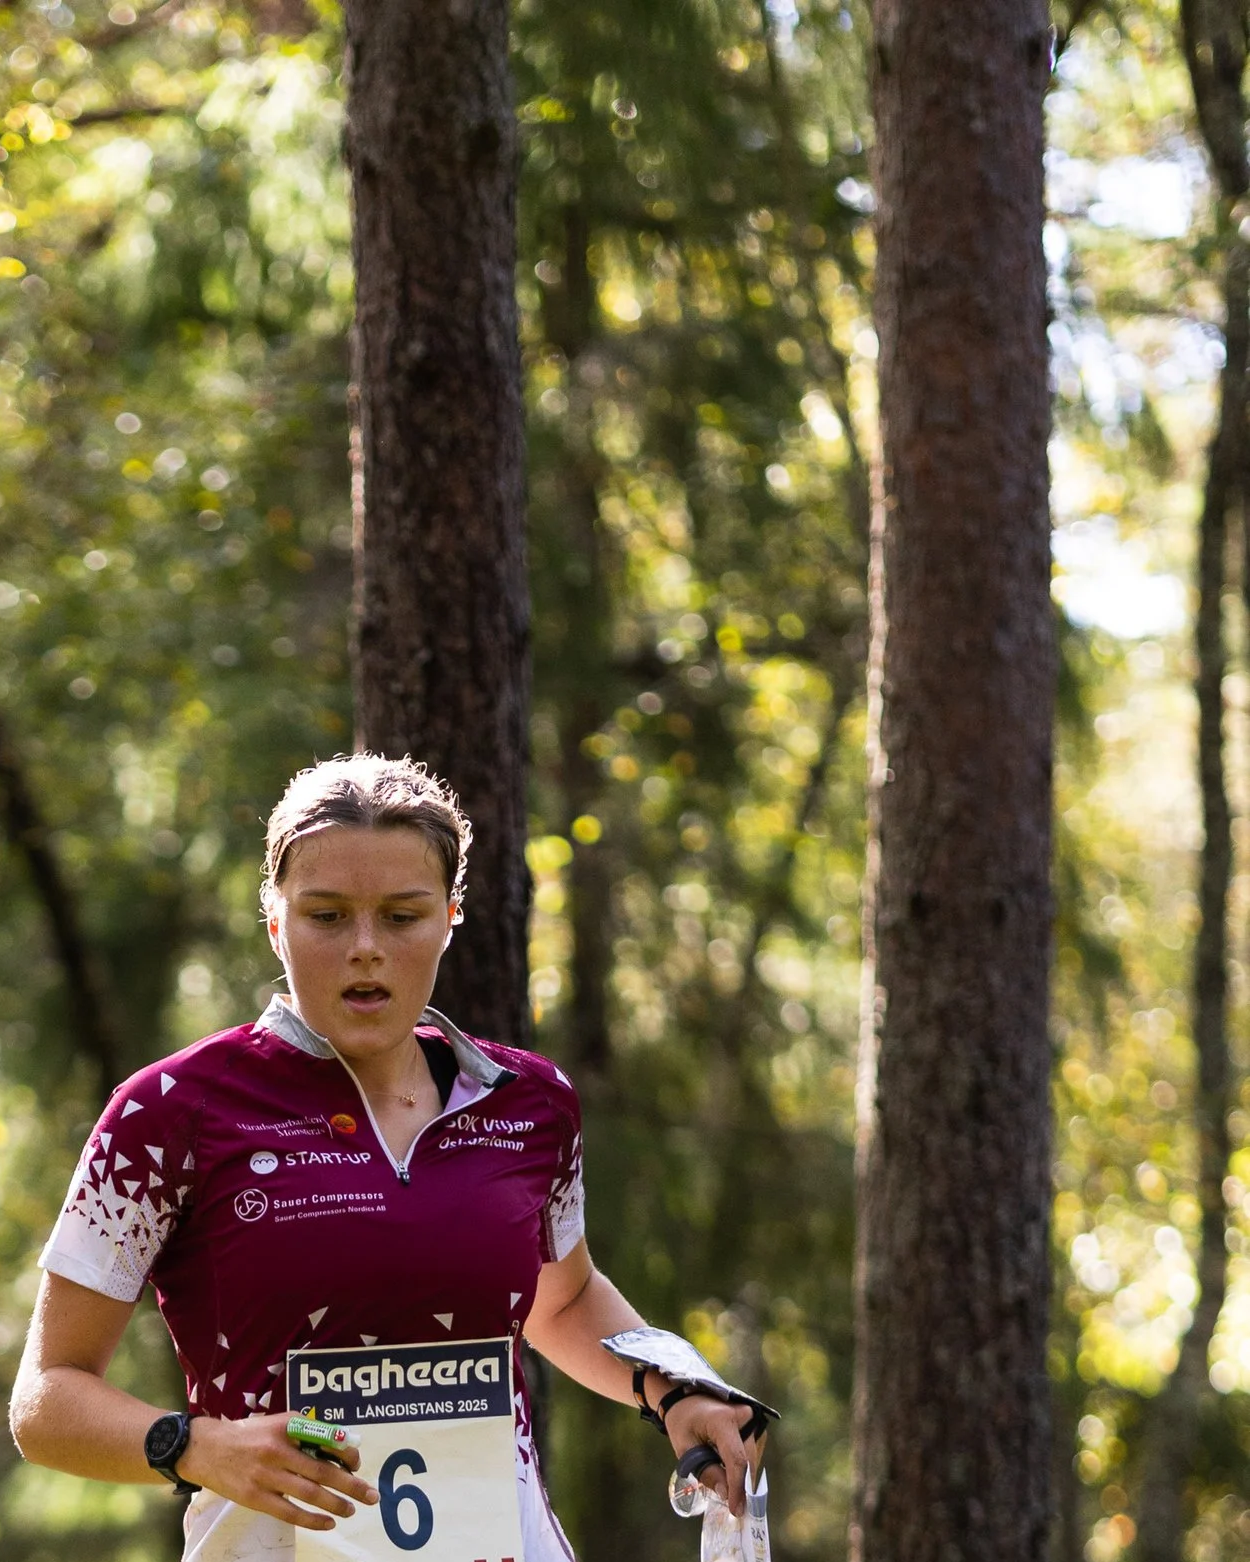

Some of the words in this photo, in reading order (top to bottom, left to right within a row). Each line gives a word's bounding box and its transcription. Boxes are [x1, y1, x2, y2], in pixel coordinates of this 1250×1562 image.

[483, 1117, 535, 1134] Viljan
[285, 1151, 372, 1166] START-UP
[273, 1197, 308, 1209] Sauer
[311, 1192, 384, 1204] Compressors
[274, 1213, 296, 1223] Sauer
[297, 1207, 346, 1219] Compressors
[347, 1205, 375, 1213] Nordics
[376, 1204, 386, 1212] AB
[300, 1357, 500, 1397] bagheera
[324, 1407, 345, 1420] SM
[356, 1400, 454, 1419] LÅNGDISTANS
[457, 1399, 489, 1413] 2025
[378, 1448, 434, 1551] 6
